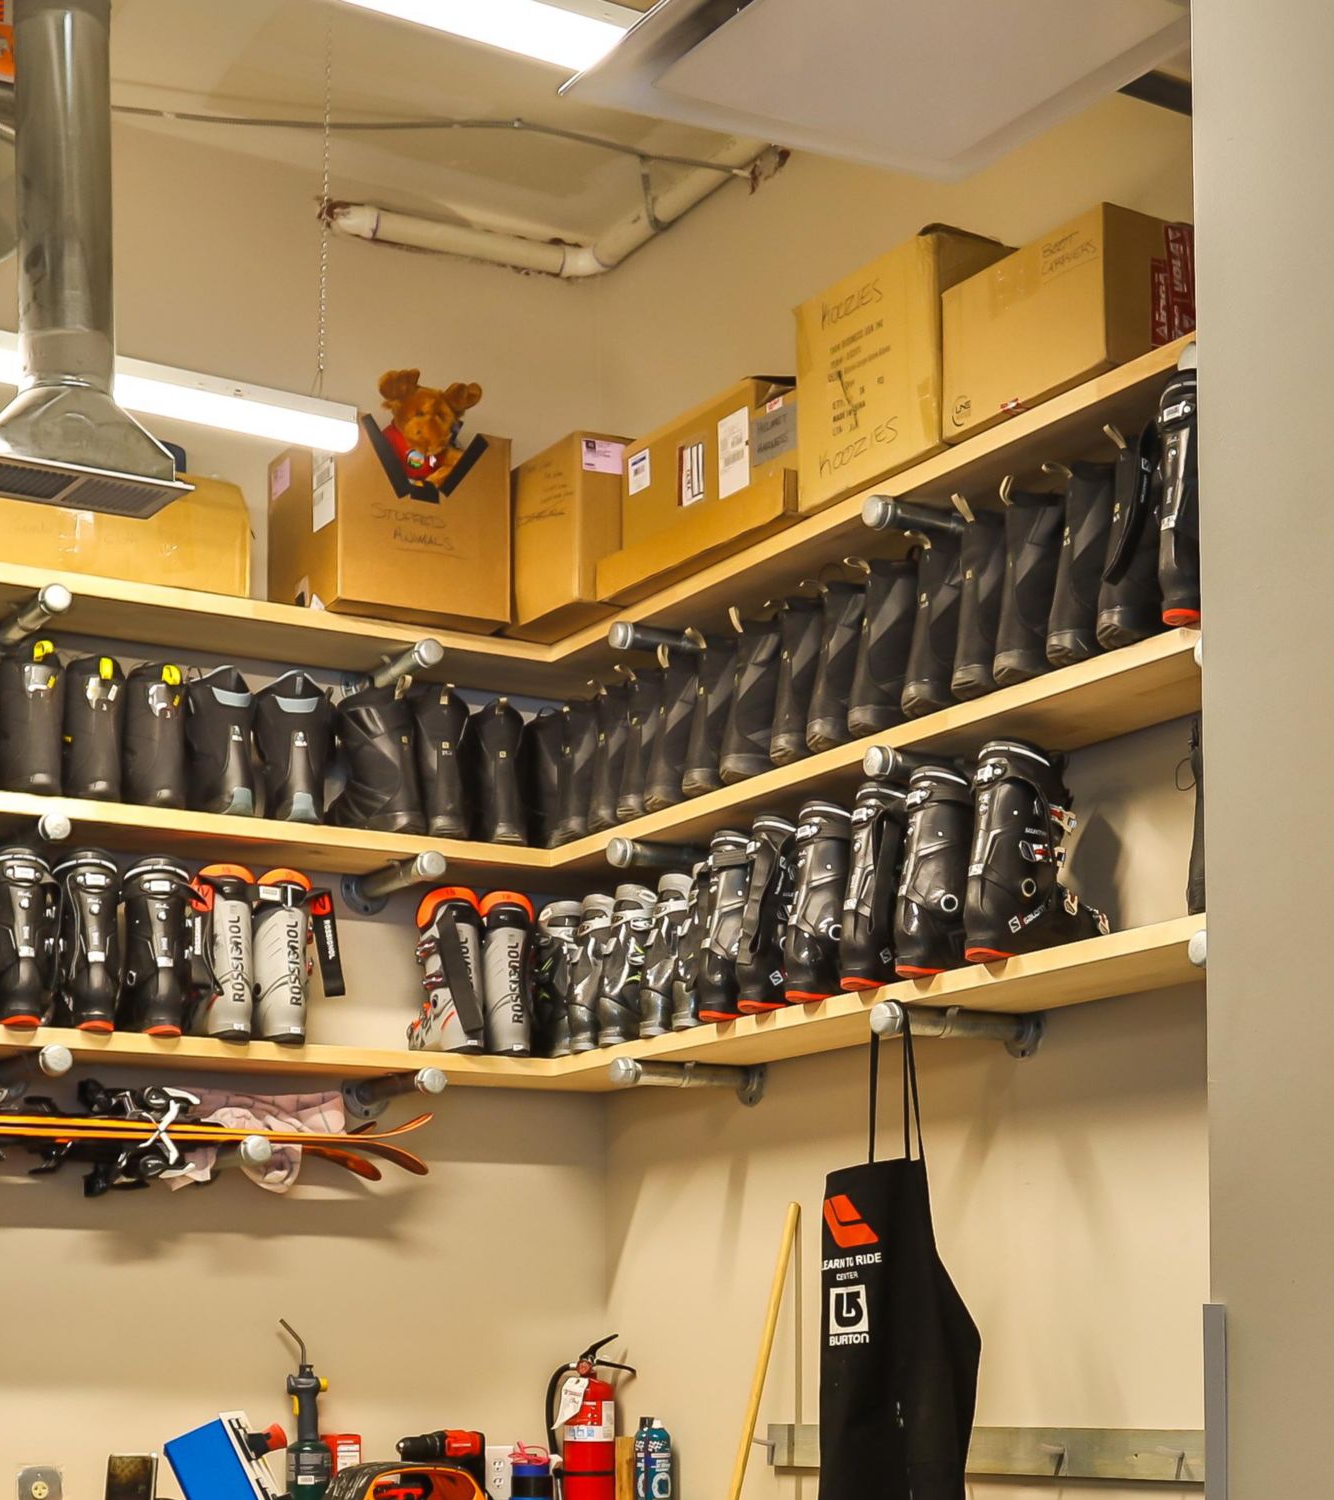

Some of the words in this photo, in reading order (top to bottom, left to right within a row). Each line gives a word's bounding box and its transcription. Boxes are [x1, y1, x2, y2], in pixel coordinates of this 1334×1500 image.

[819, 415, 898, 478] KOOZIES
[228, 915, 245, 1003] ROSSIGNOL
[286, 920, 303, 1006] ROSSIGNOL
[507, 943, 524, 1024] ROSSIGNOL
[836, 1271, 859, 1281] CENTER
[855, 1252, 882, 1266] RIDE
[829, 1333, 869, 1346] BURTON
